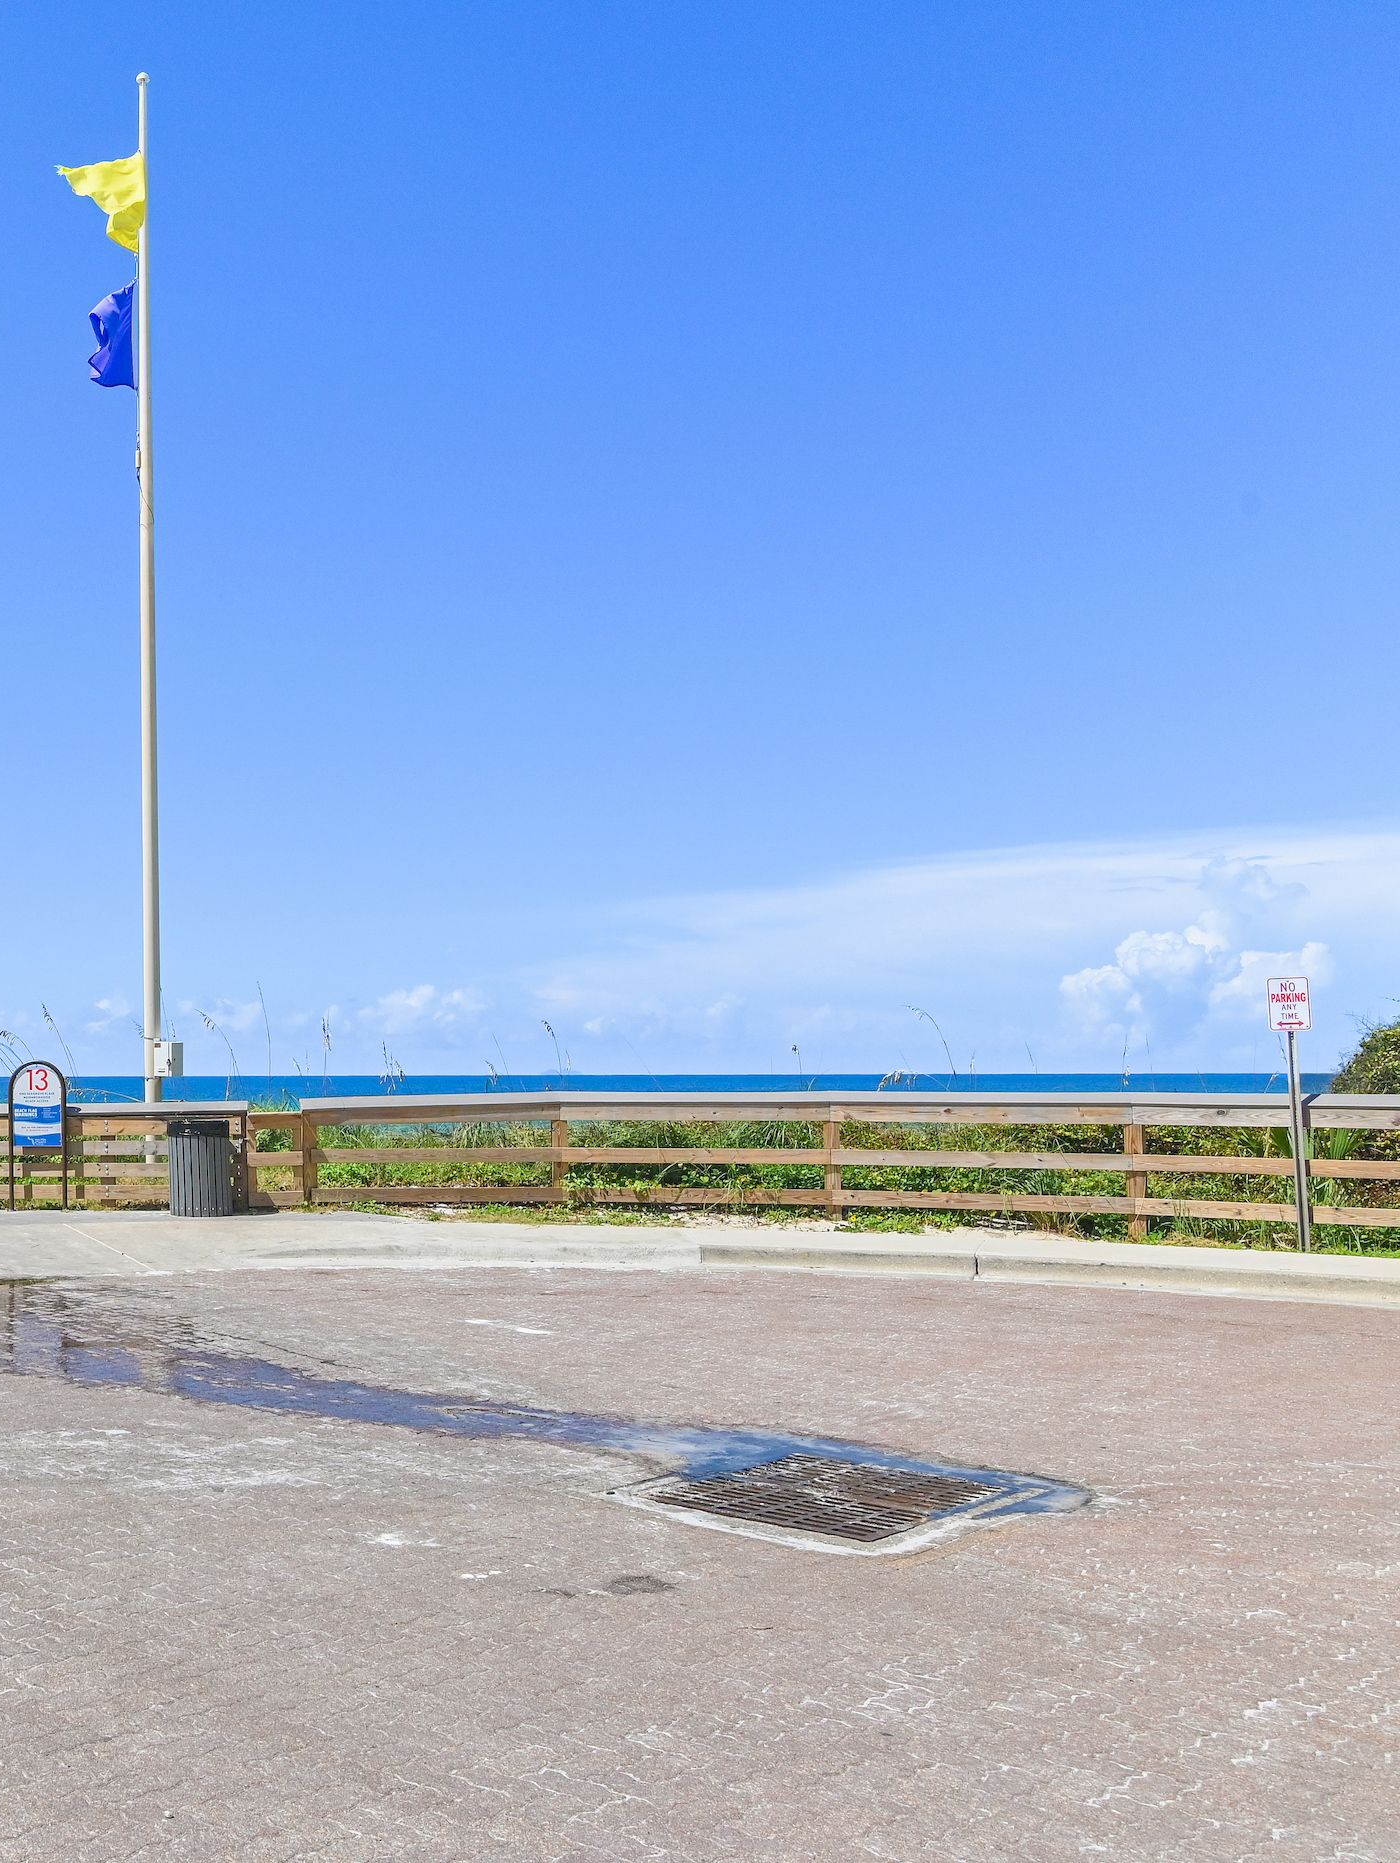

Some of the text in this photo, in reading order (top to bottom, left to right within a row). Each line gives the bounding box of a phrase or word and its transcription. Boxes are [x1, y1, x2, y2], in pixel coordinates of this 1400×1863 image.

[1280, 982, 1295, 992] NO
[1271, 993, 1306, 1003] PARKING
[26, 1069, 49, 1091] 13
